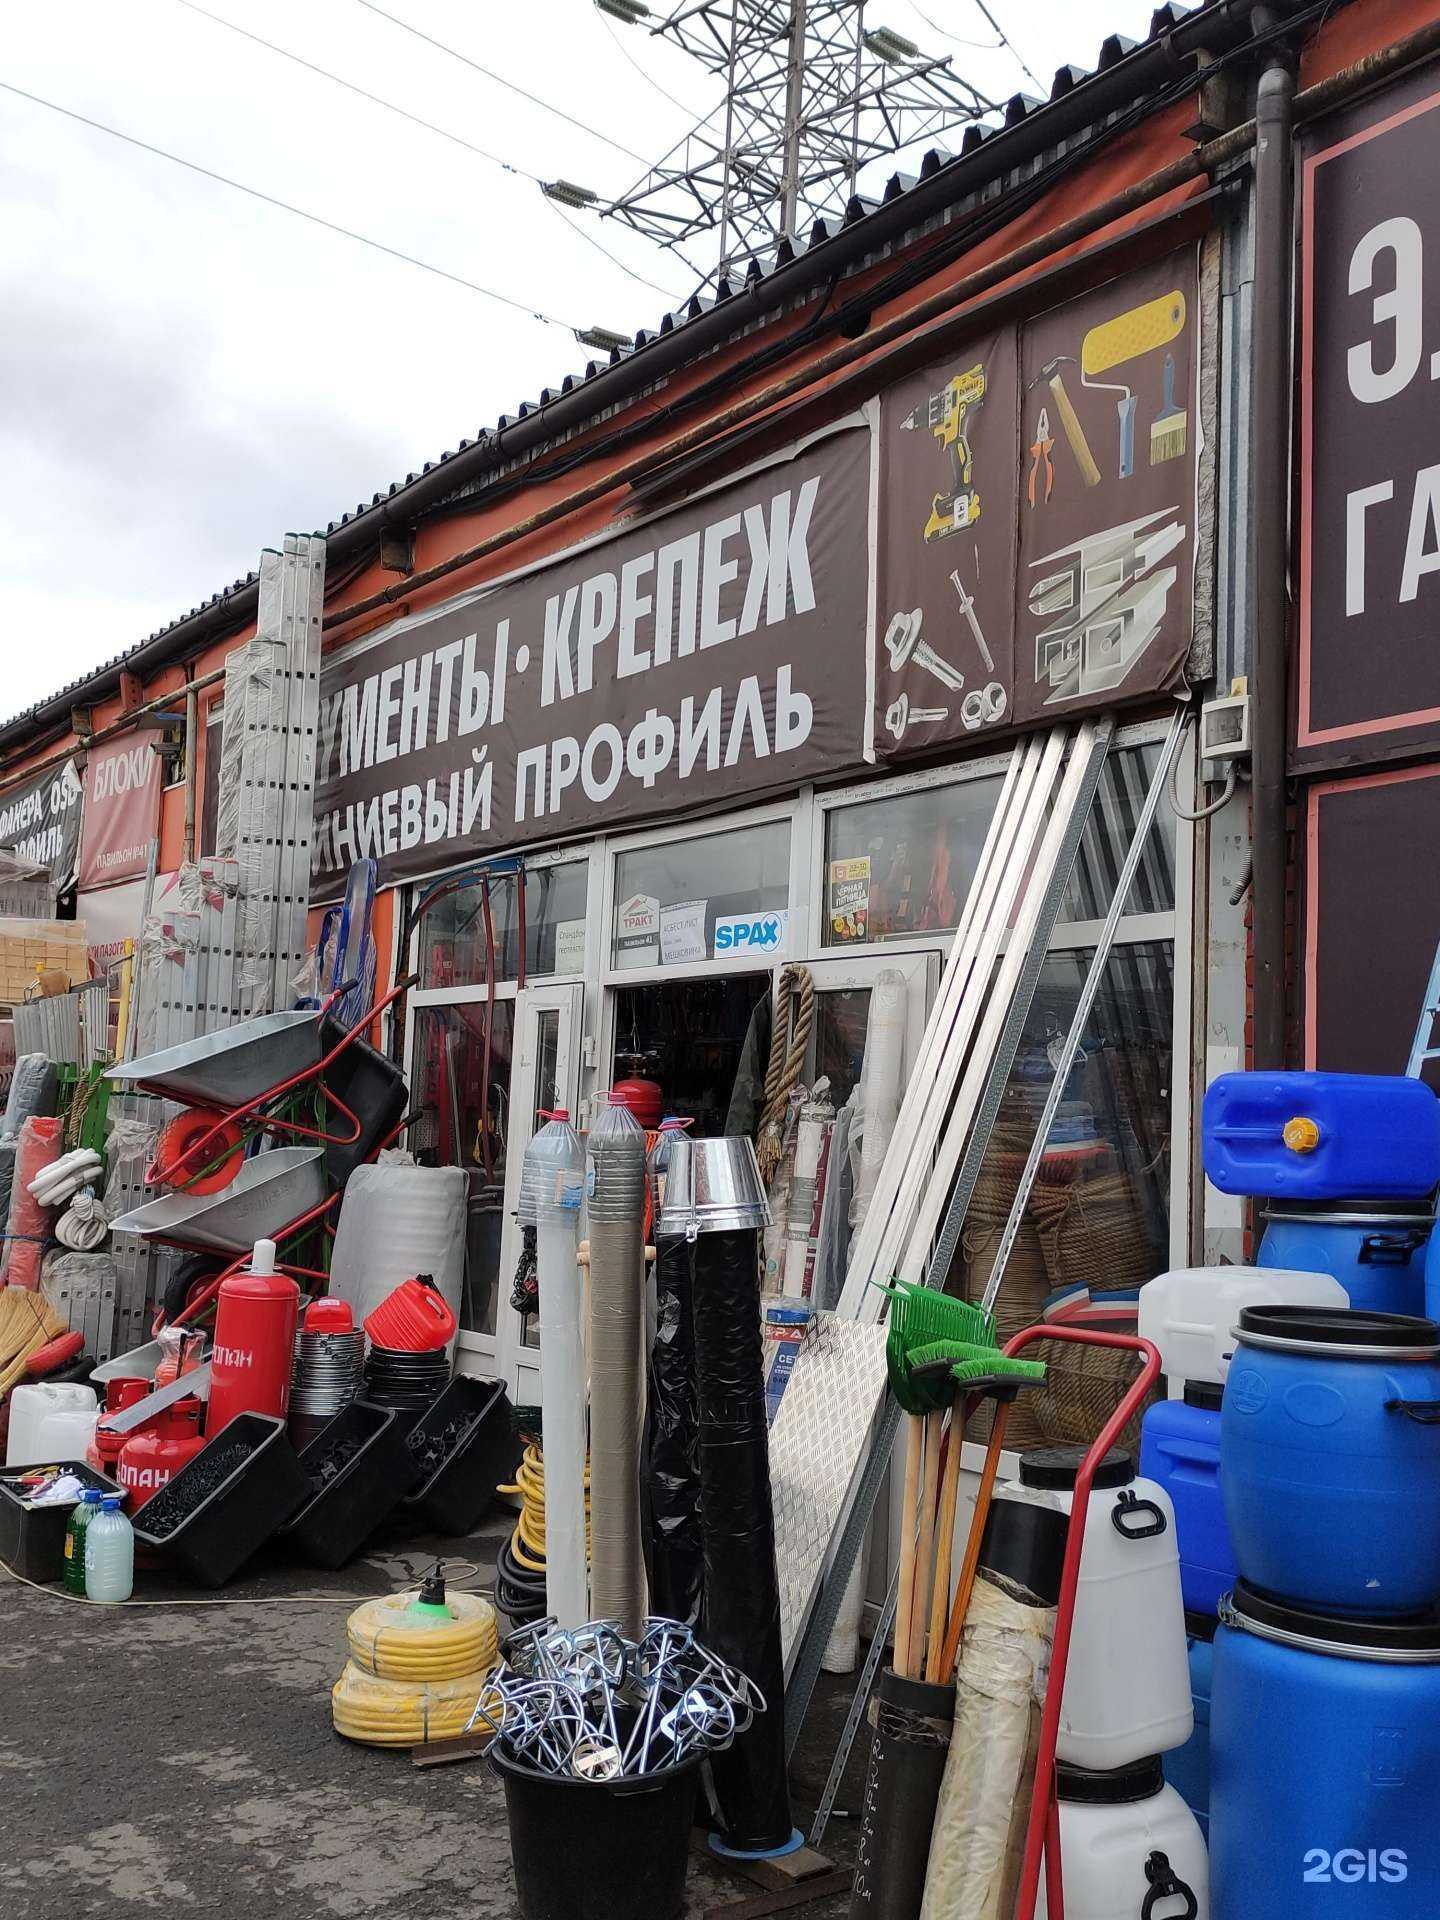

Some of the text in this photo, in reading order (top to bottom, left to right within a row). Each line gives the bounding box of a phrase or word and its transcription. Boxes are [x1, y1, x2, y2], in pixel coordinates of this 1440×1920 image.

[1347, 216, 1440, 404] Э
[540, 476, 821, 708] КРЕПЕЖ
[514, 664, 814, 823] ПРОФИЛЬ
[94, 745, 156, 803] БЛОКИ
[623, 914, 654, 928] ТРАКТ
[715, 920, 778, 949] SPAX
[213, 1344, 253, 1368] ОПАН
